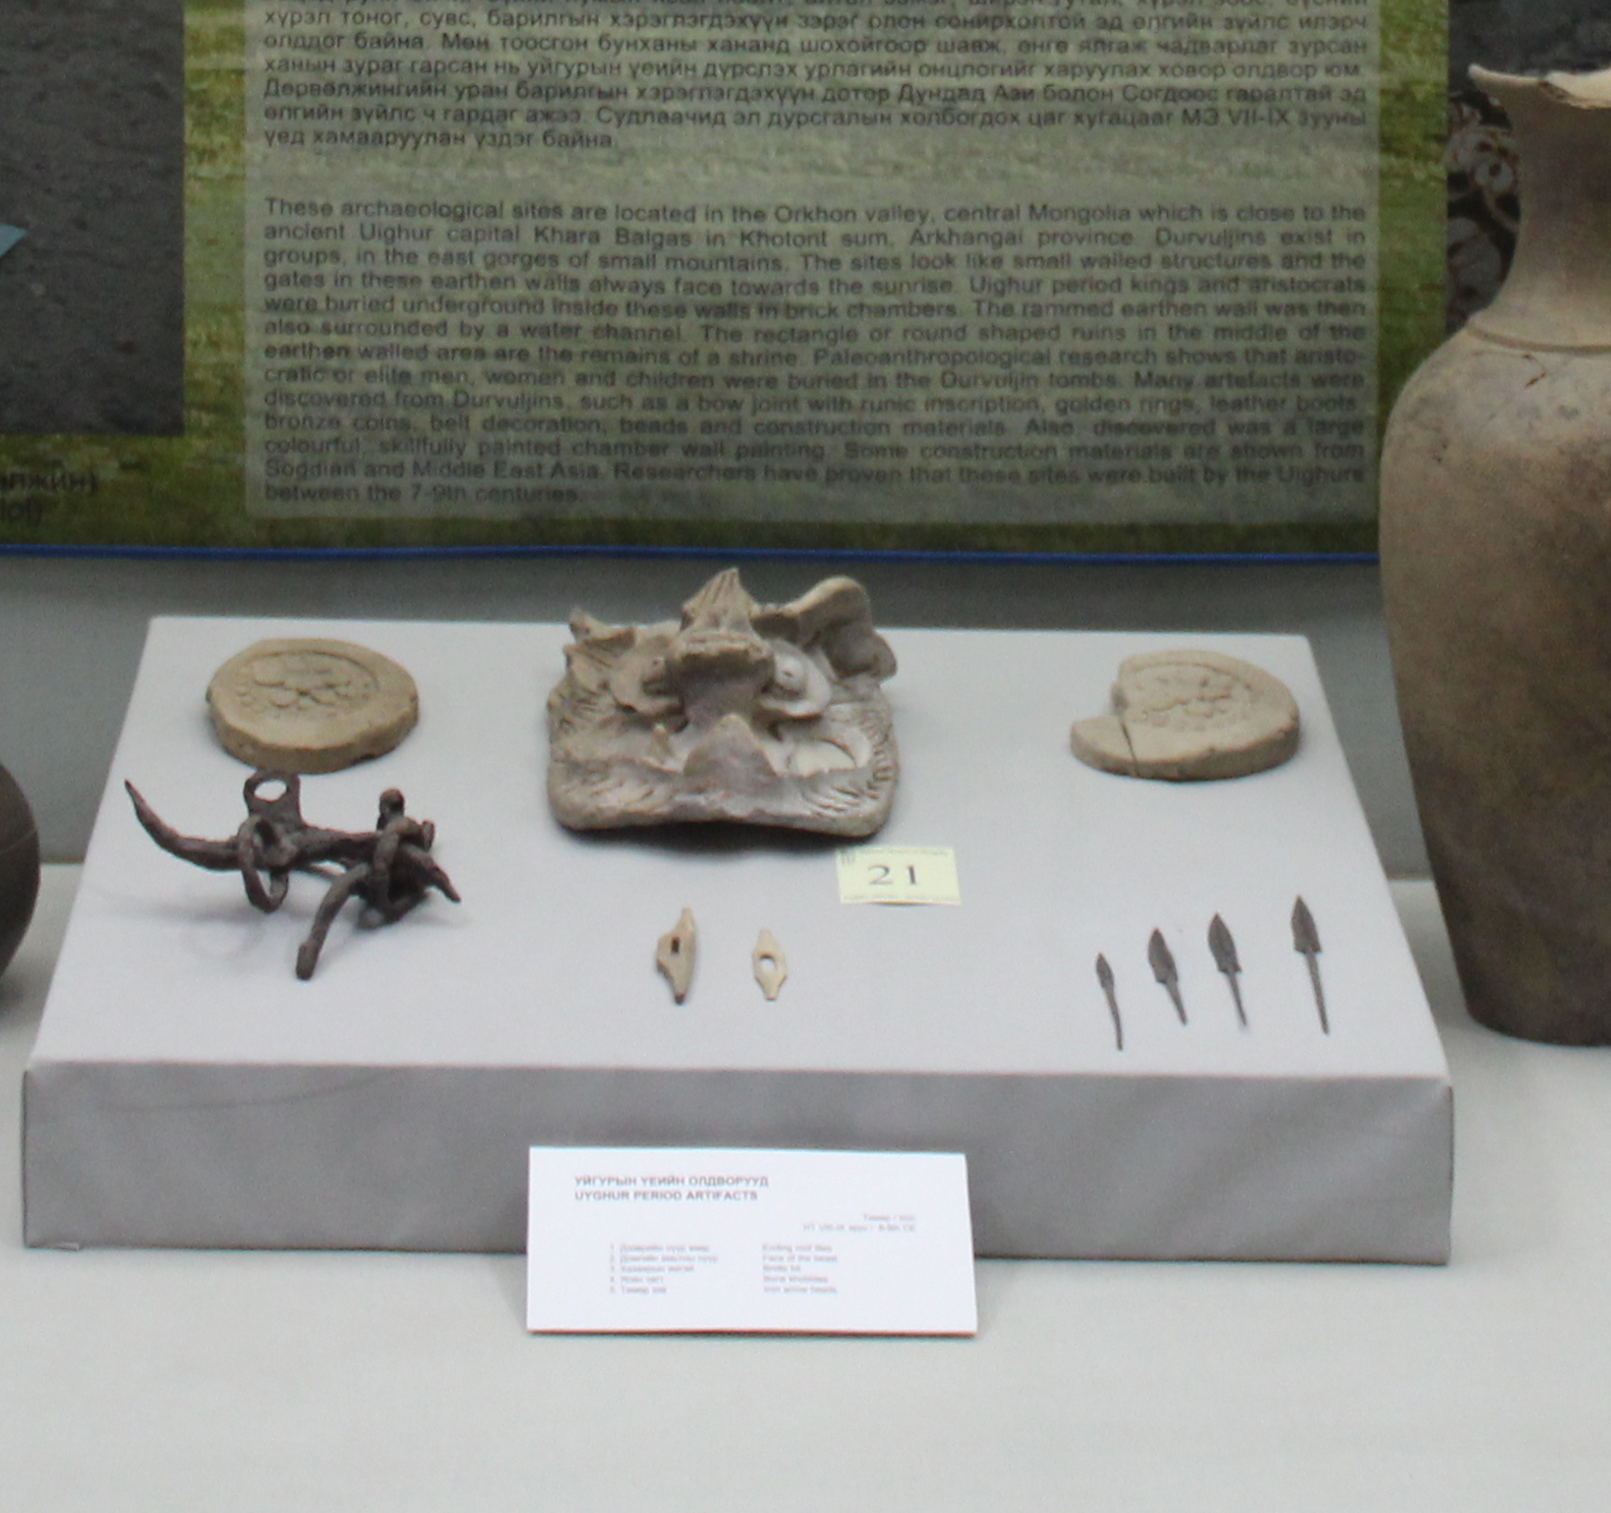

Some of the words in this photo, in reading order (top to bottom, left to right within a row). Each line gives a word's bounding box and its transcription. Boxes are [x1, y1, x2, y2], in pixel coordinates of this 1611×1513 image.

[574, 1190, 630, 1201] UYGHUR
[633, 1190, 683, 1201] PERIOD
[685, 1190, 759, 1201] ARTIFACTS
